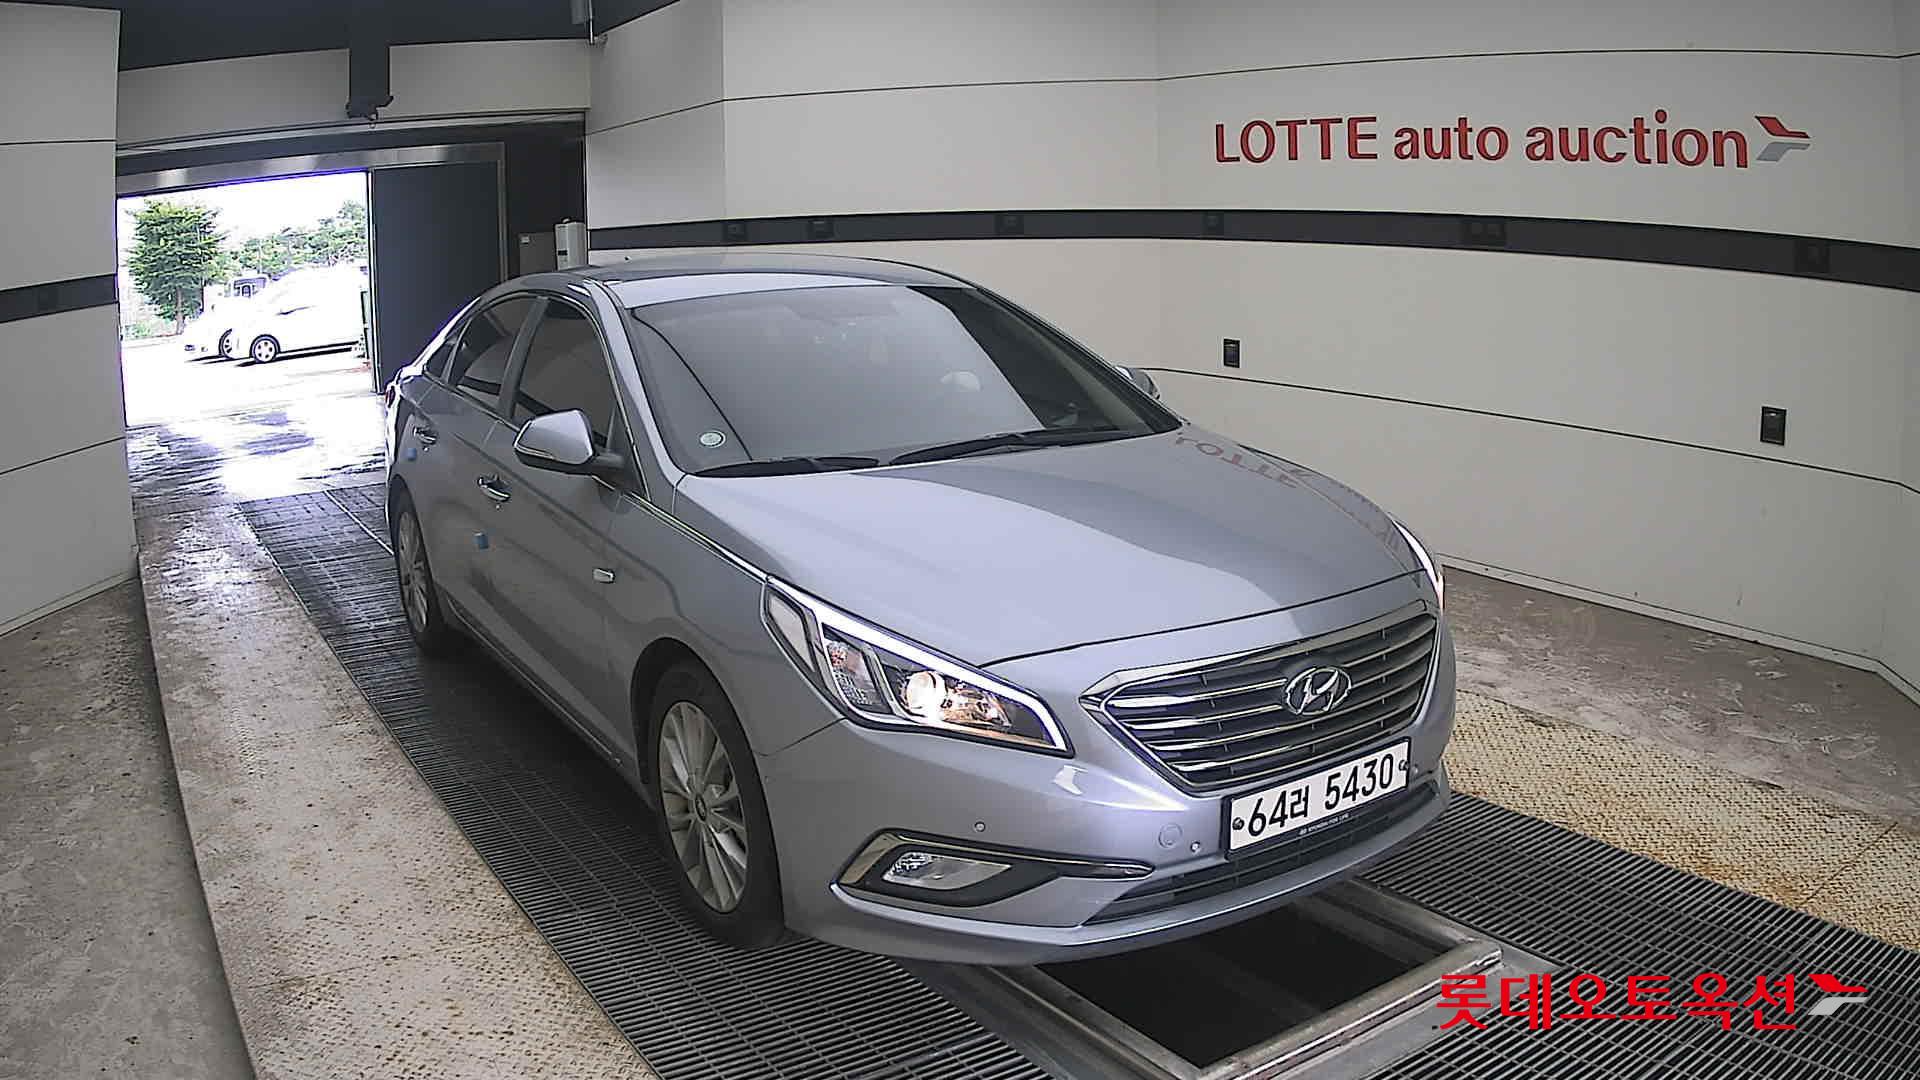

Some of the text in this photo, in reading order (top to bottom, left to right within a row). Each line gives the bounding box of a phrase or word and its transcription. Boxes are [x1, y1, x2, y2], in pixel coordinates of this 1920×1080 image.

[1215, 110, 1749, 168] LOTTE auto auction
[1248, 785, 1309, 836] 64러
[1325, 754, 1393, 810] 5430
